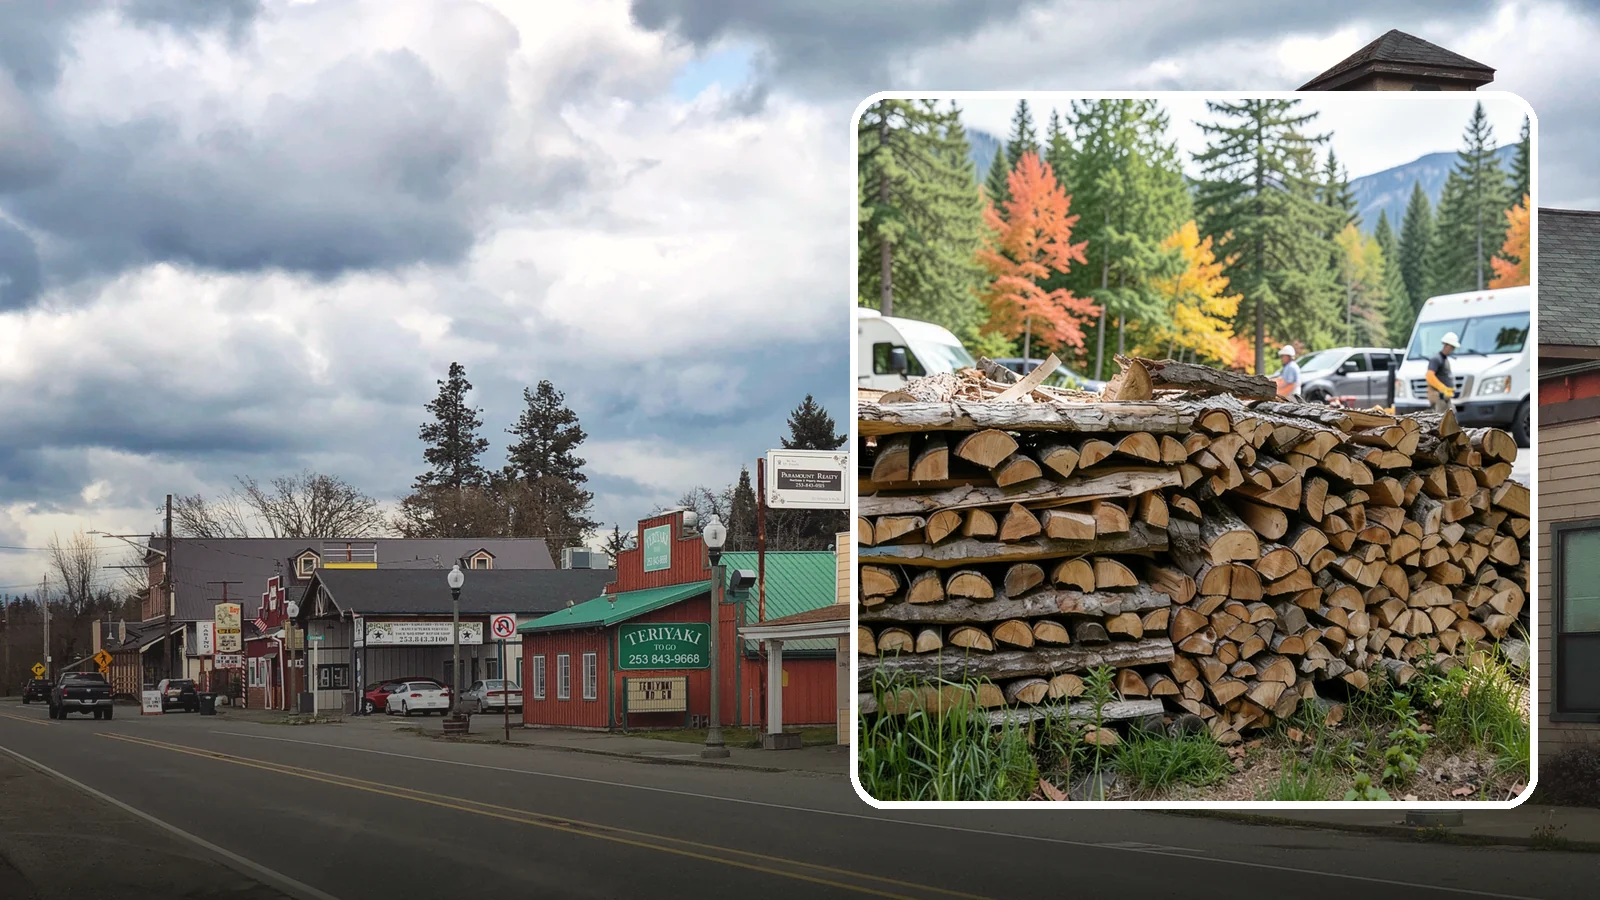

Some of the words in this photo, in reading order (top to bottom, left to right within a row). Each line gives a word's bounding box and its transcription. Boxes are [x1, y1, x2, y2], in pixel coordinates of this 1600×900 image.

[817, 472, 839, 480] REALTY
[624, 627, 702, 646] TERIYAKI
[628, 654, 648, 665] 253
[651, 653, 700, 665] 843-9668
[639, 681, 672, 691] TERIYAKI
